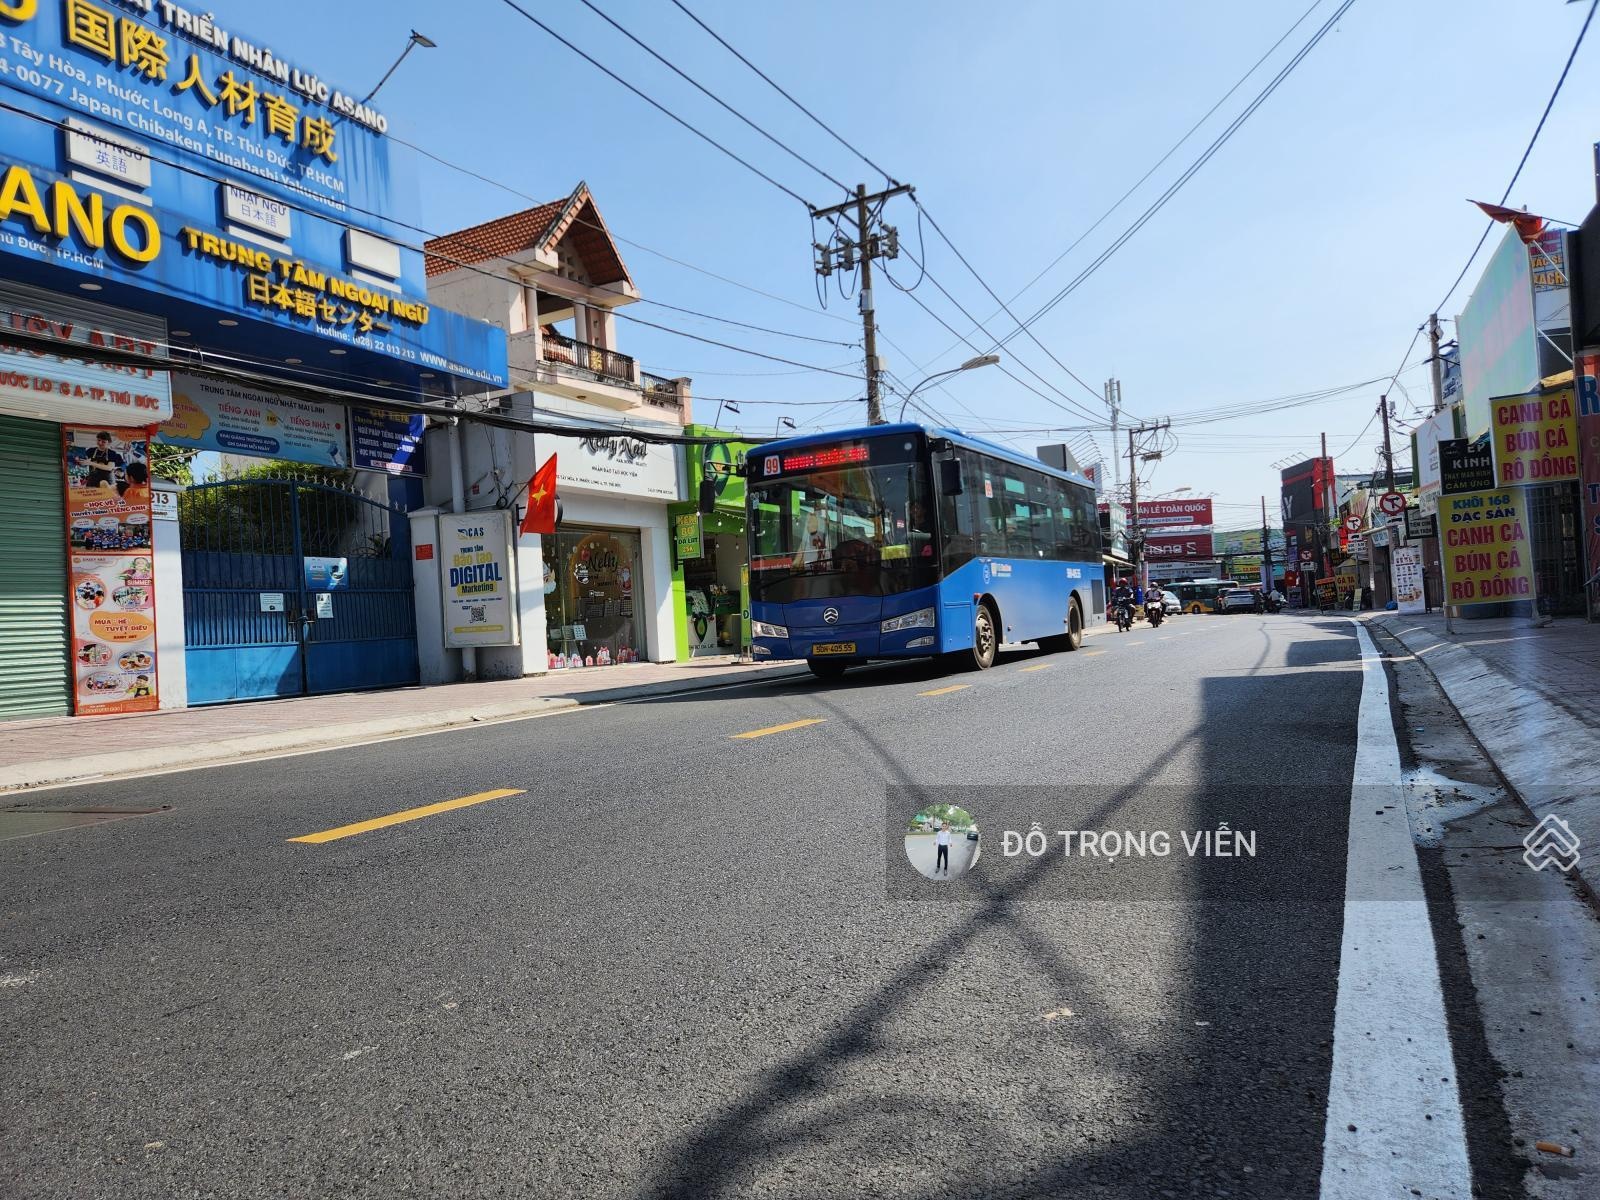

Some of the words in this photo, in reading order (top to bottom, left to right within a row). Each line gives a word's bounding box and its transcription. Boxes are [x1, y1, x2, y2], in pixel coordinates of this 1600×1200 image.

[161, 0, 228, 51] TRIỂN
[232, 37, 289, 82] NHÂN
[292, 69, 329, 101] LỰC
[333, 91, 388, 133] ASANO
[10, 36, 43, 66] Tây
[49, 54, 91, 86] Hòa,
[96, 74, 150, 110] Phước
[153, 99, 193, 131] Long
[197, 119, 212, 139] A,
[214, 126, 235, 146] TP.
[237, 136, 263, 158] Thủ
[298, 163, 345, 194] TP.HCM
[69, 87, 123, 121] Japan
[127, 111, 202, 157] Chibaken
[206, 143, 278, 181] Funabashi
[241, 205, 276, 228] 日本語
[56, 247, 104, 270] TP.HCM
[184, 226, 272, 273] TRUNG
[278, 259, 326, 291] TÂM
[331, 277, 389, 313] NGOẠI
[393, 300, 430, 325] NGỮ
[248, 274, 393, 332] 日本語センター
[316, 323, 351, 342] Hotline:
[374, 340, 385, 351] 22
[200, 384, 225, 397] TRUNG
[226, 386, 242, 398] TÂM
[218, 402, 242, 416] TIẾNG
[243, 407, 261, 419] ANH
[290, 416, 310, 428] TIẾNG
[1497, 401, 1543, 426] CANH
[1505, 428, 1541, 453] BÚN
[1545, 423, 1569, 448] CÁ
[765, 458, 779, 474] 99
[1503, 457, 1525, 481] RÔ
[1529, 450, 1577, 479] ĐỒNG
[131, 504, 147, 512] ANH
[1137, 504, 1150, 514] ÁN
[1161, 503, 1183, 513] TOÀN
[1184, 502, 1207, 512] QUỐC
[1488, 494, 1510, 506] 168
[1485, 506, 1515, 520] SẢN
[1446, 525, 1495, 548] CANH
[1500, 519, 1525, 543] CÁ
[1455, 550, 1492, 574] BÚN
[1497, 546, 1521, 570] CÁ
[450, 562, 502, 587] DIGITAL
[1451, 577, 1475, 600] RÔ
[1480, 572, 1530, 598] ĐỒNG
[461, 582, 494, 594] Marketing
